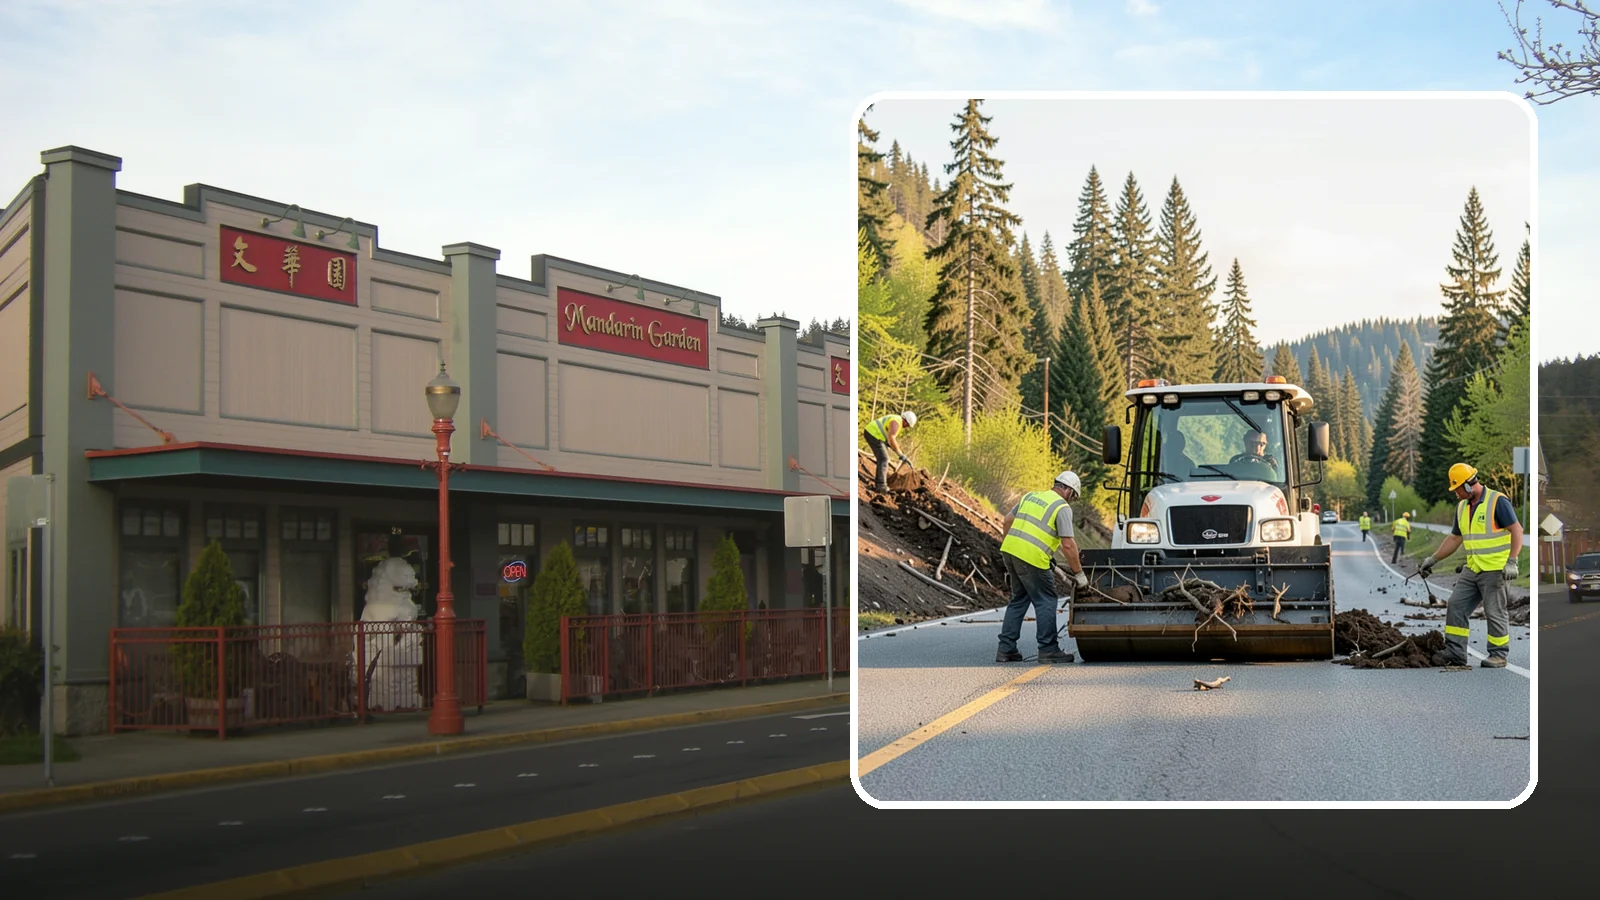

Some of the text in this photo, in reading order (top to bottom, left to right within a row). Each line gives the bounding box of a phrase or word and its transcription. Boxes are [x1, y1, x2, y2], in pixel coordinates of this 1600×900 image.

[230, 235, 346, 291] 文華園
[564, 302, 701, 352] Mandarin Garden
[834, 362, 846, 386] 文
[503, 565, 527, 578] OPEN
